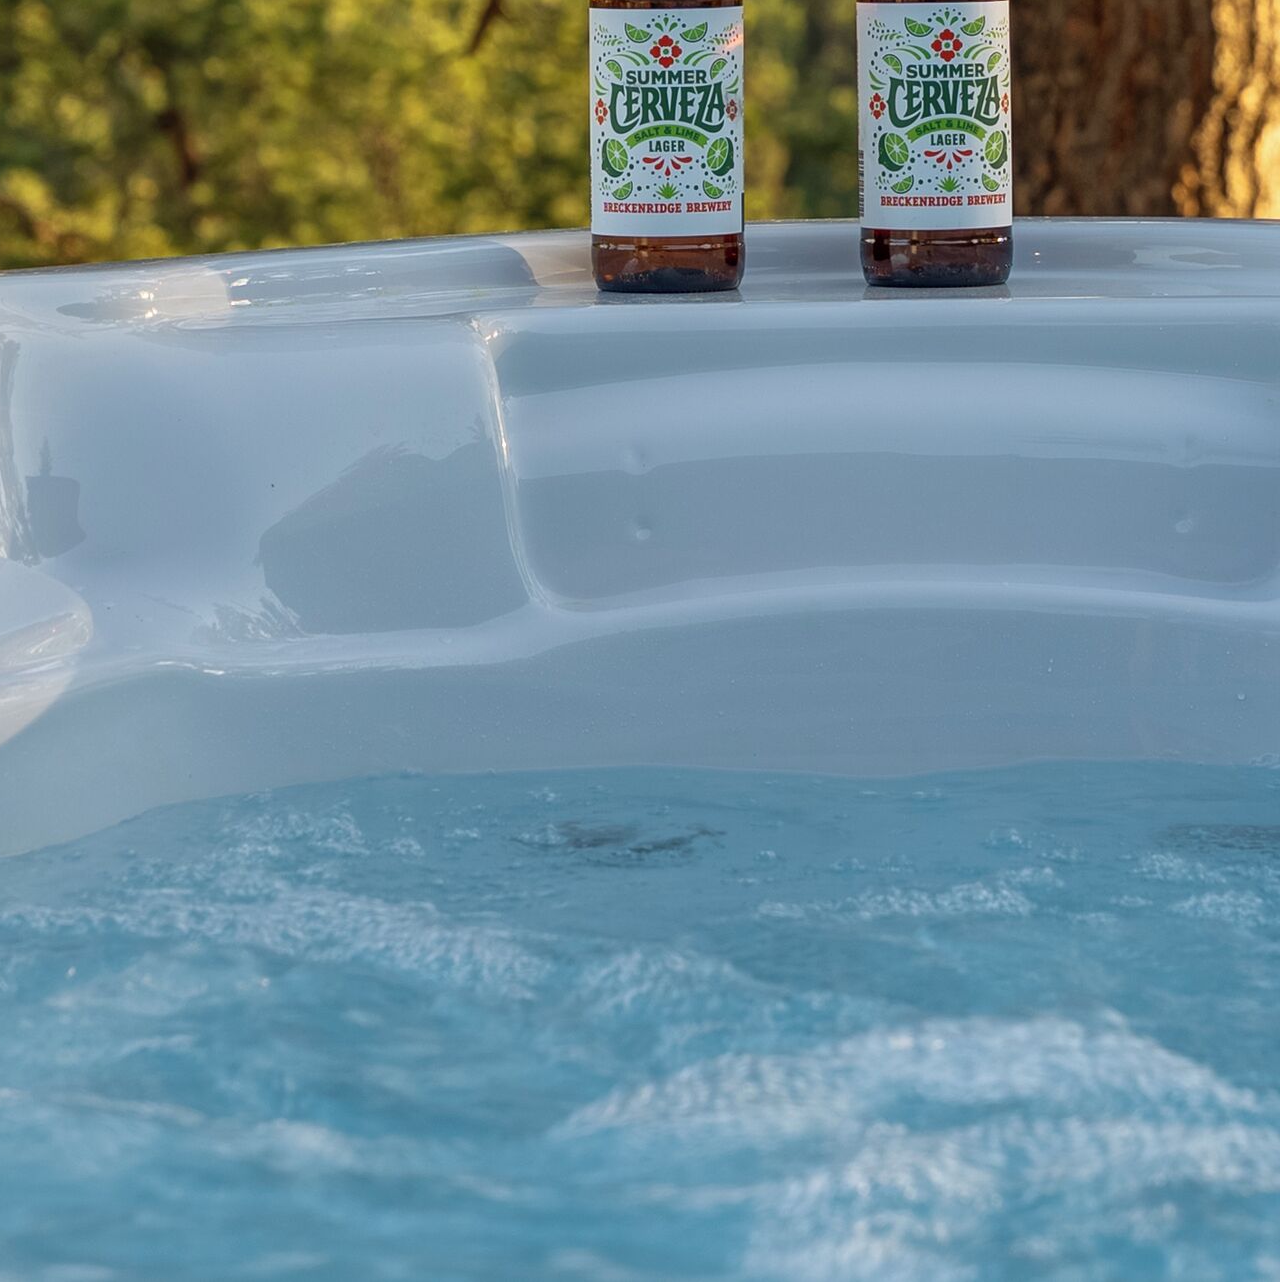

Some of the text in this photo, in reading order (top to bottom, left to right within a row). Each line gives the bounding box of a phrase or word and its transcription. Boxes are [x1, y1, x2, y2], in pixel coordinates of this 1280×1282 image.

[626, 69, 707, 85] SUMMER
[906, 63, 985, 78] SUMMER
[608, 81, 726, 134] CERVEZA
[887, 74, 1001, 128] CERVEZA
[634, 125, 700, 142] SALT & LIME
[915, 119, 980, 136] SALT & LIME
[649, 140, 685, 152] LAGER
[930, 133, 966, 146] LAGER
[603, 200, 732, 213] BRECKENRIDGE BREWERY
[880, 193, 1006, 206] BRECKENRIDGE BREWERY
